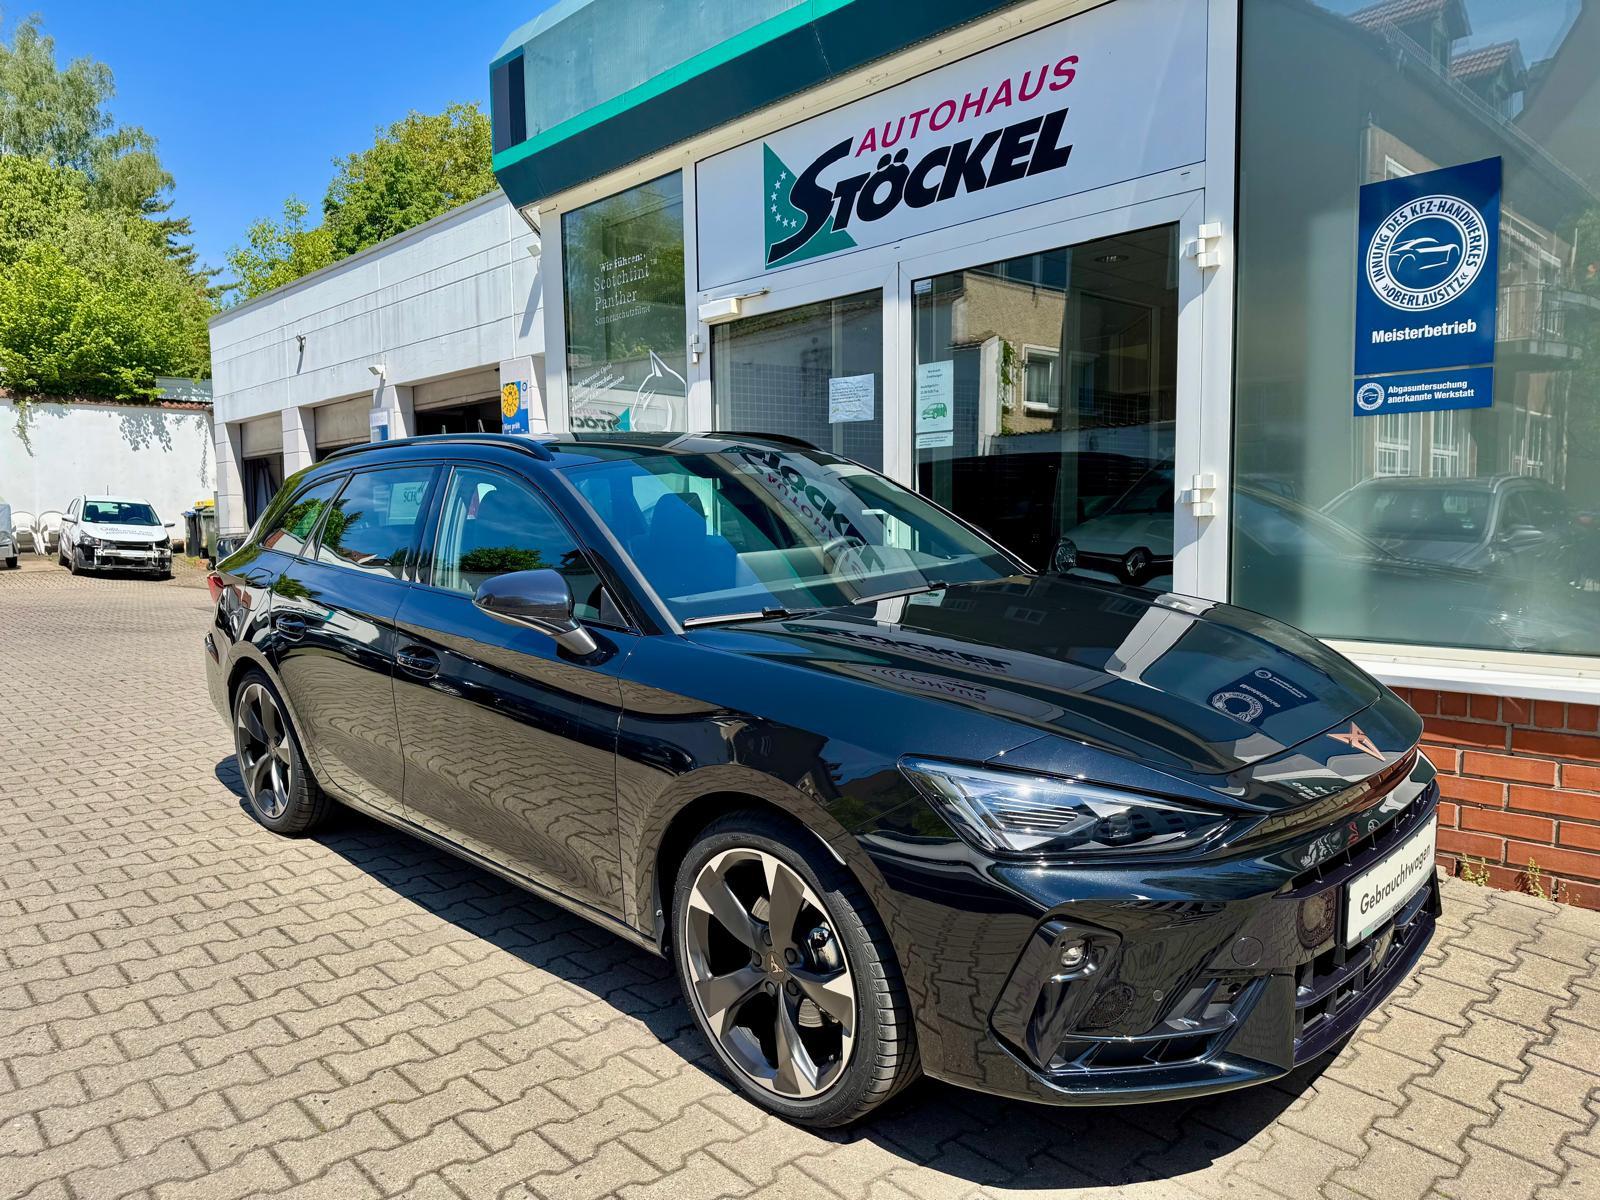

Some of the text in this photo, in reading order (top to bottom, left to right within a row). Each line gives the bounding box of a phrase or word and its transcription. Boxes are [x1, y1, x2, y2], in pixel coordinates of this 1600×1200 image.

[855, 55, 1079, 157] AUTOHAUS
[767, 107, 1073, 265] STÖCKEL
[1371, 200, 1483, 283] INNUNG DES KFZ-HANDWERKES
[593, 263, 649, 292] Scotchtint
[599, 261, 612, 272] Wir
[594, 290, 637, 311] Panther
[1372, 319, 1477, 344] Meisterbetrieb
[1388, 380, 1468, 394] Abgasuntersuchung
[1388, 389, 1475, 404] anerkannte Werkstatt
[1360, 844, 1431, 915] Gebrauchtwagen
